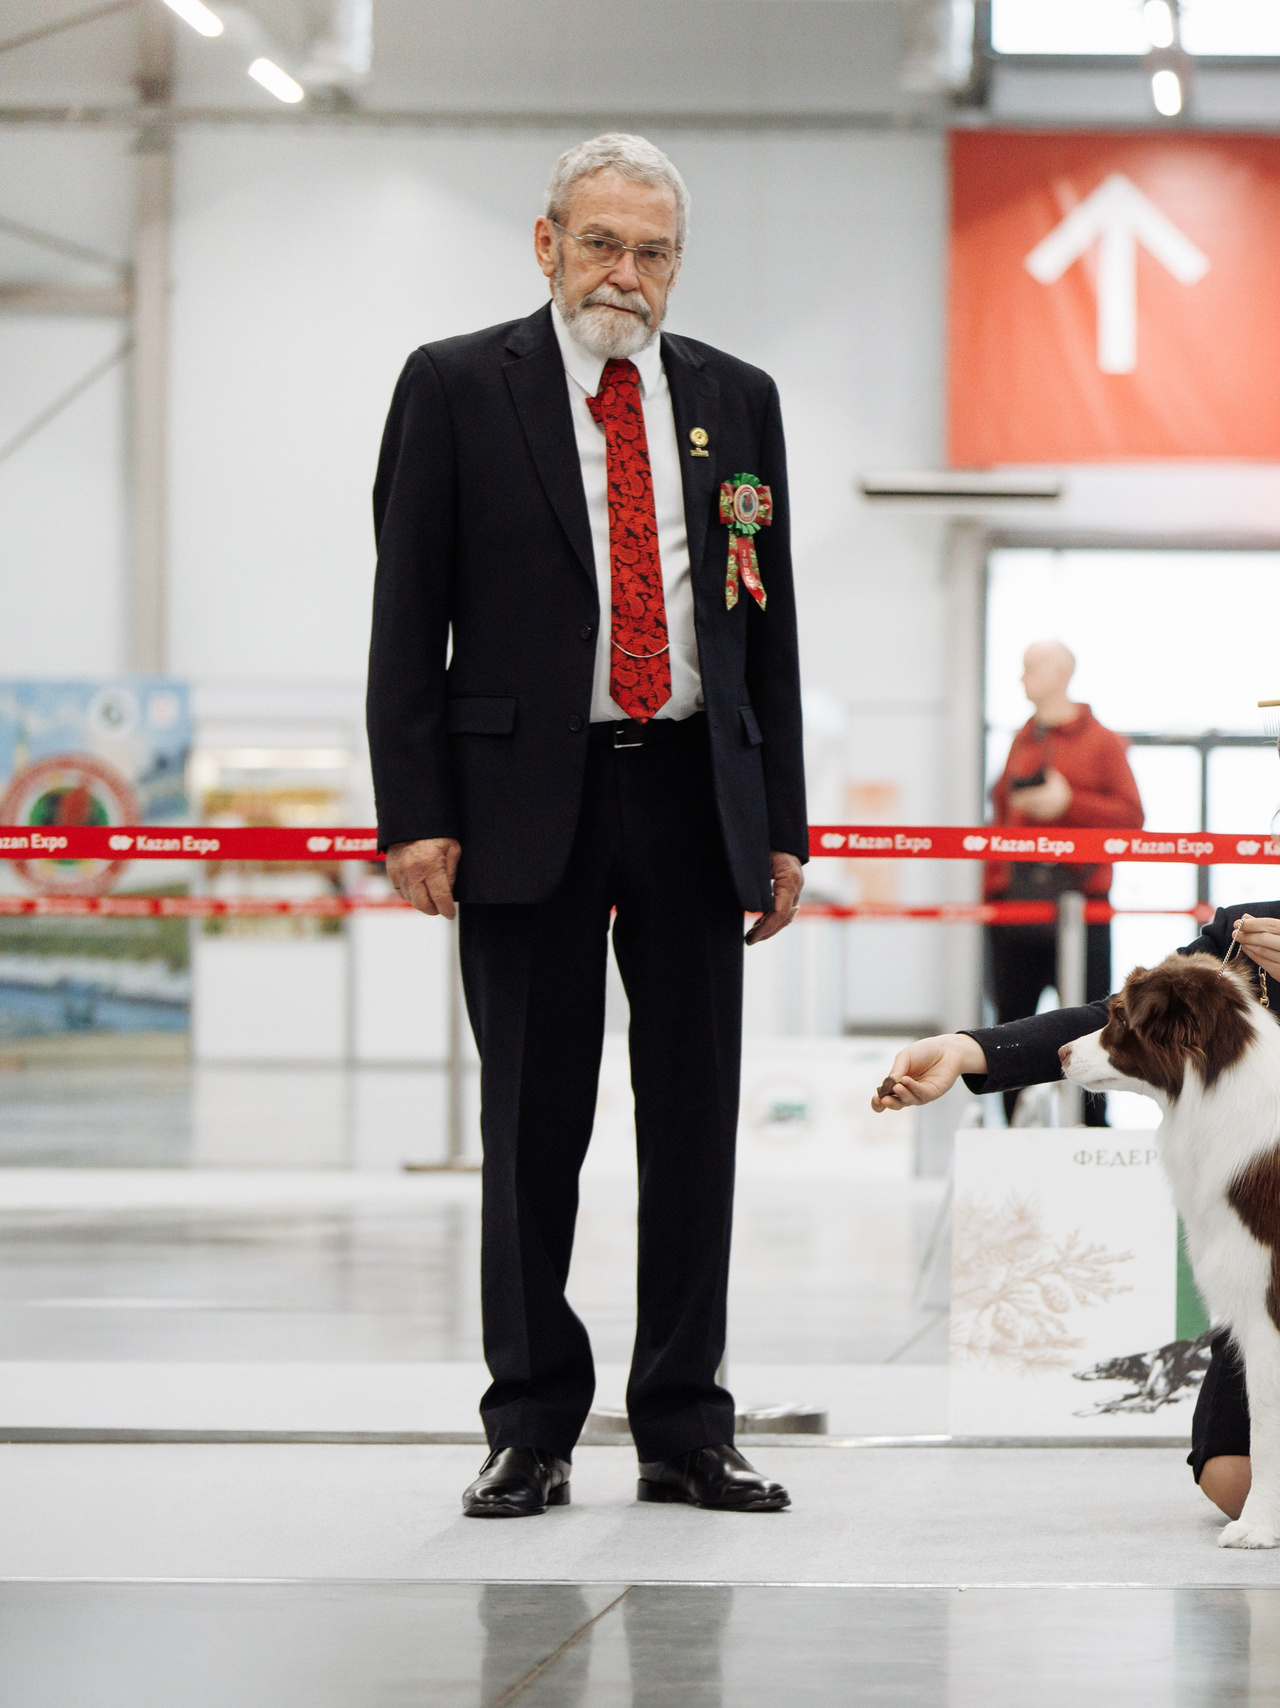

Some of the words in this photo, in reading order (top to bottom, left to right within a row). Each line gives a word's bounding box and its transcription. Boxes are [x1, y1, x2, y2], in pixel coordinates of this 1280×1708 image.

[0, 837, 28, 849] zan
[31, 833, 67, 851] Expo
[137, 836, 180, 850] Kazan
[183, 835, 219, 854] Expo
[849, 833, 893, 849] Kazan
[895, 833, 931, 852] Expo
[991, 835, 1035, 852] Kazan
[1037, 836, 1074, 856] Expo
[1131, 838, 1175, 854] Kazan
[1177, 838, 1214, 857] Expo
[1073, 1149, 1159, 1166] ФЕДЕР
